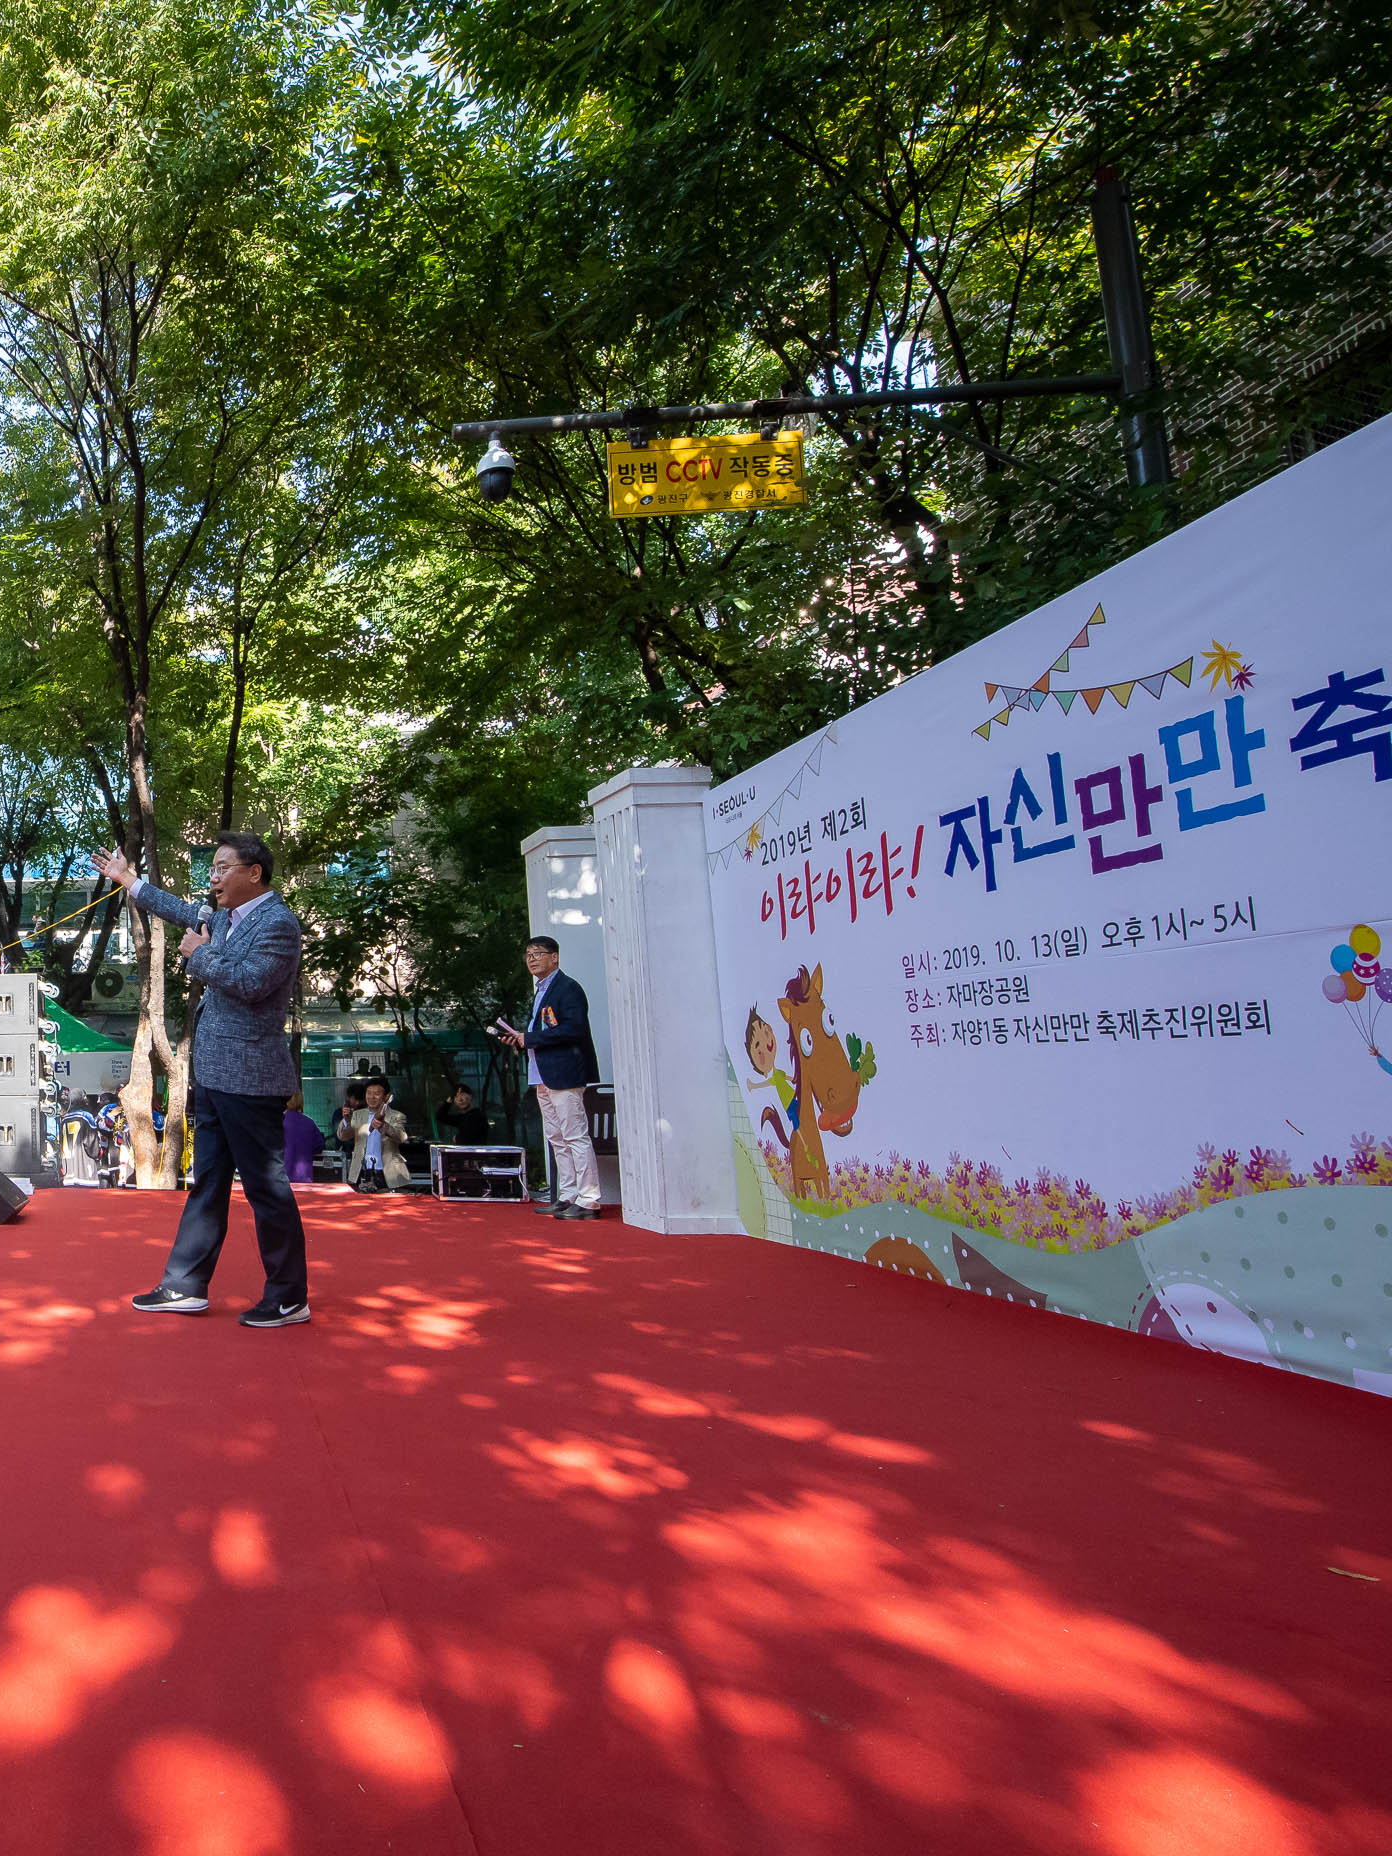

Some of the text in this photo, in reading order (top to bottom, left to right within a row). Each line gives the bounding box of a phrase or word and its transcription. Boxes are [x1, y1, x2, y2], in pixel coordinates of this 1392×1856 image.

[617, 453, 794, 486] 방범 CCTV 작동중
[658, 493, 688, 504] 광진구
[761, 824, 926, 941] 이랴이랴!
[938, 694, 1267, 893] 자신만만
[761, 796, 868, 866] 2019년 제2회
[902, 951, 939, 979] 일시:
[943, 944, 987, 971] 2019.
[995, 939, 1021, 963] 10.
[1031, 926, 1088, 959] 13(일)
[1101, 916, 1146, 949] 오후
[1213, 895, 1257, 933] 5시
[905, 974, 1031, 1014] 장소: 자마장공원
[909, 999, 1272, 1049] 주최: 자양1동 자신만만 축제추진위원회
